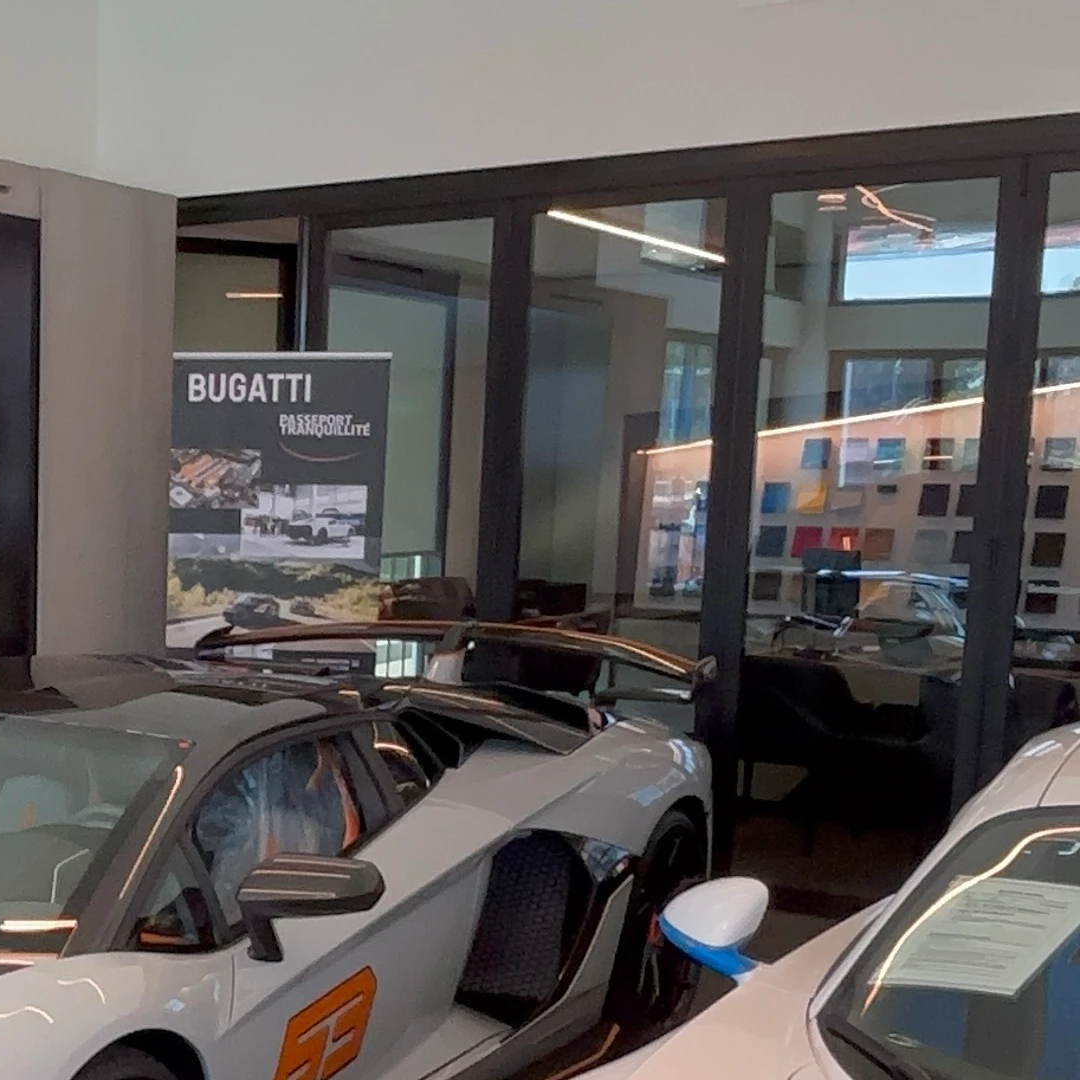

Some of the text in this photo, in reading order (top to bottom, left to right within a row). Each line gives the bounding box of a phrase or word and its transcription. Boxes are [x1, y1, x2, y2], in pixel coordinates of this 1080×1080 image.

[187, 373, 312, 403] BUGATTI
[279, 414, 354, 427] PASSEPORT
[280, 421, 370, 438] TRANQUILLITÉ
